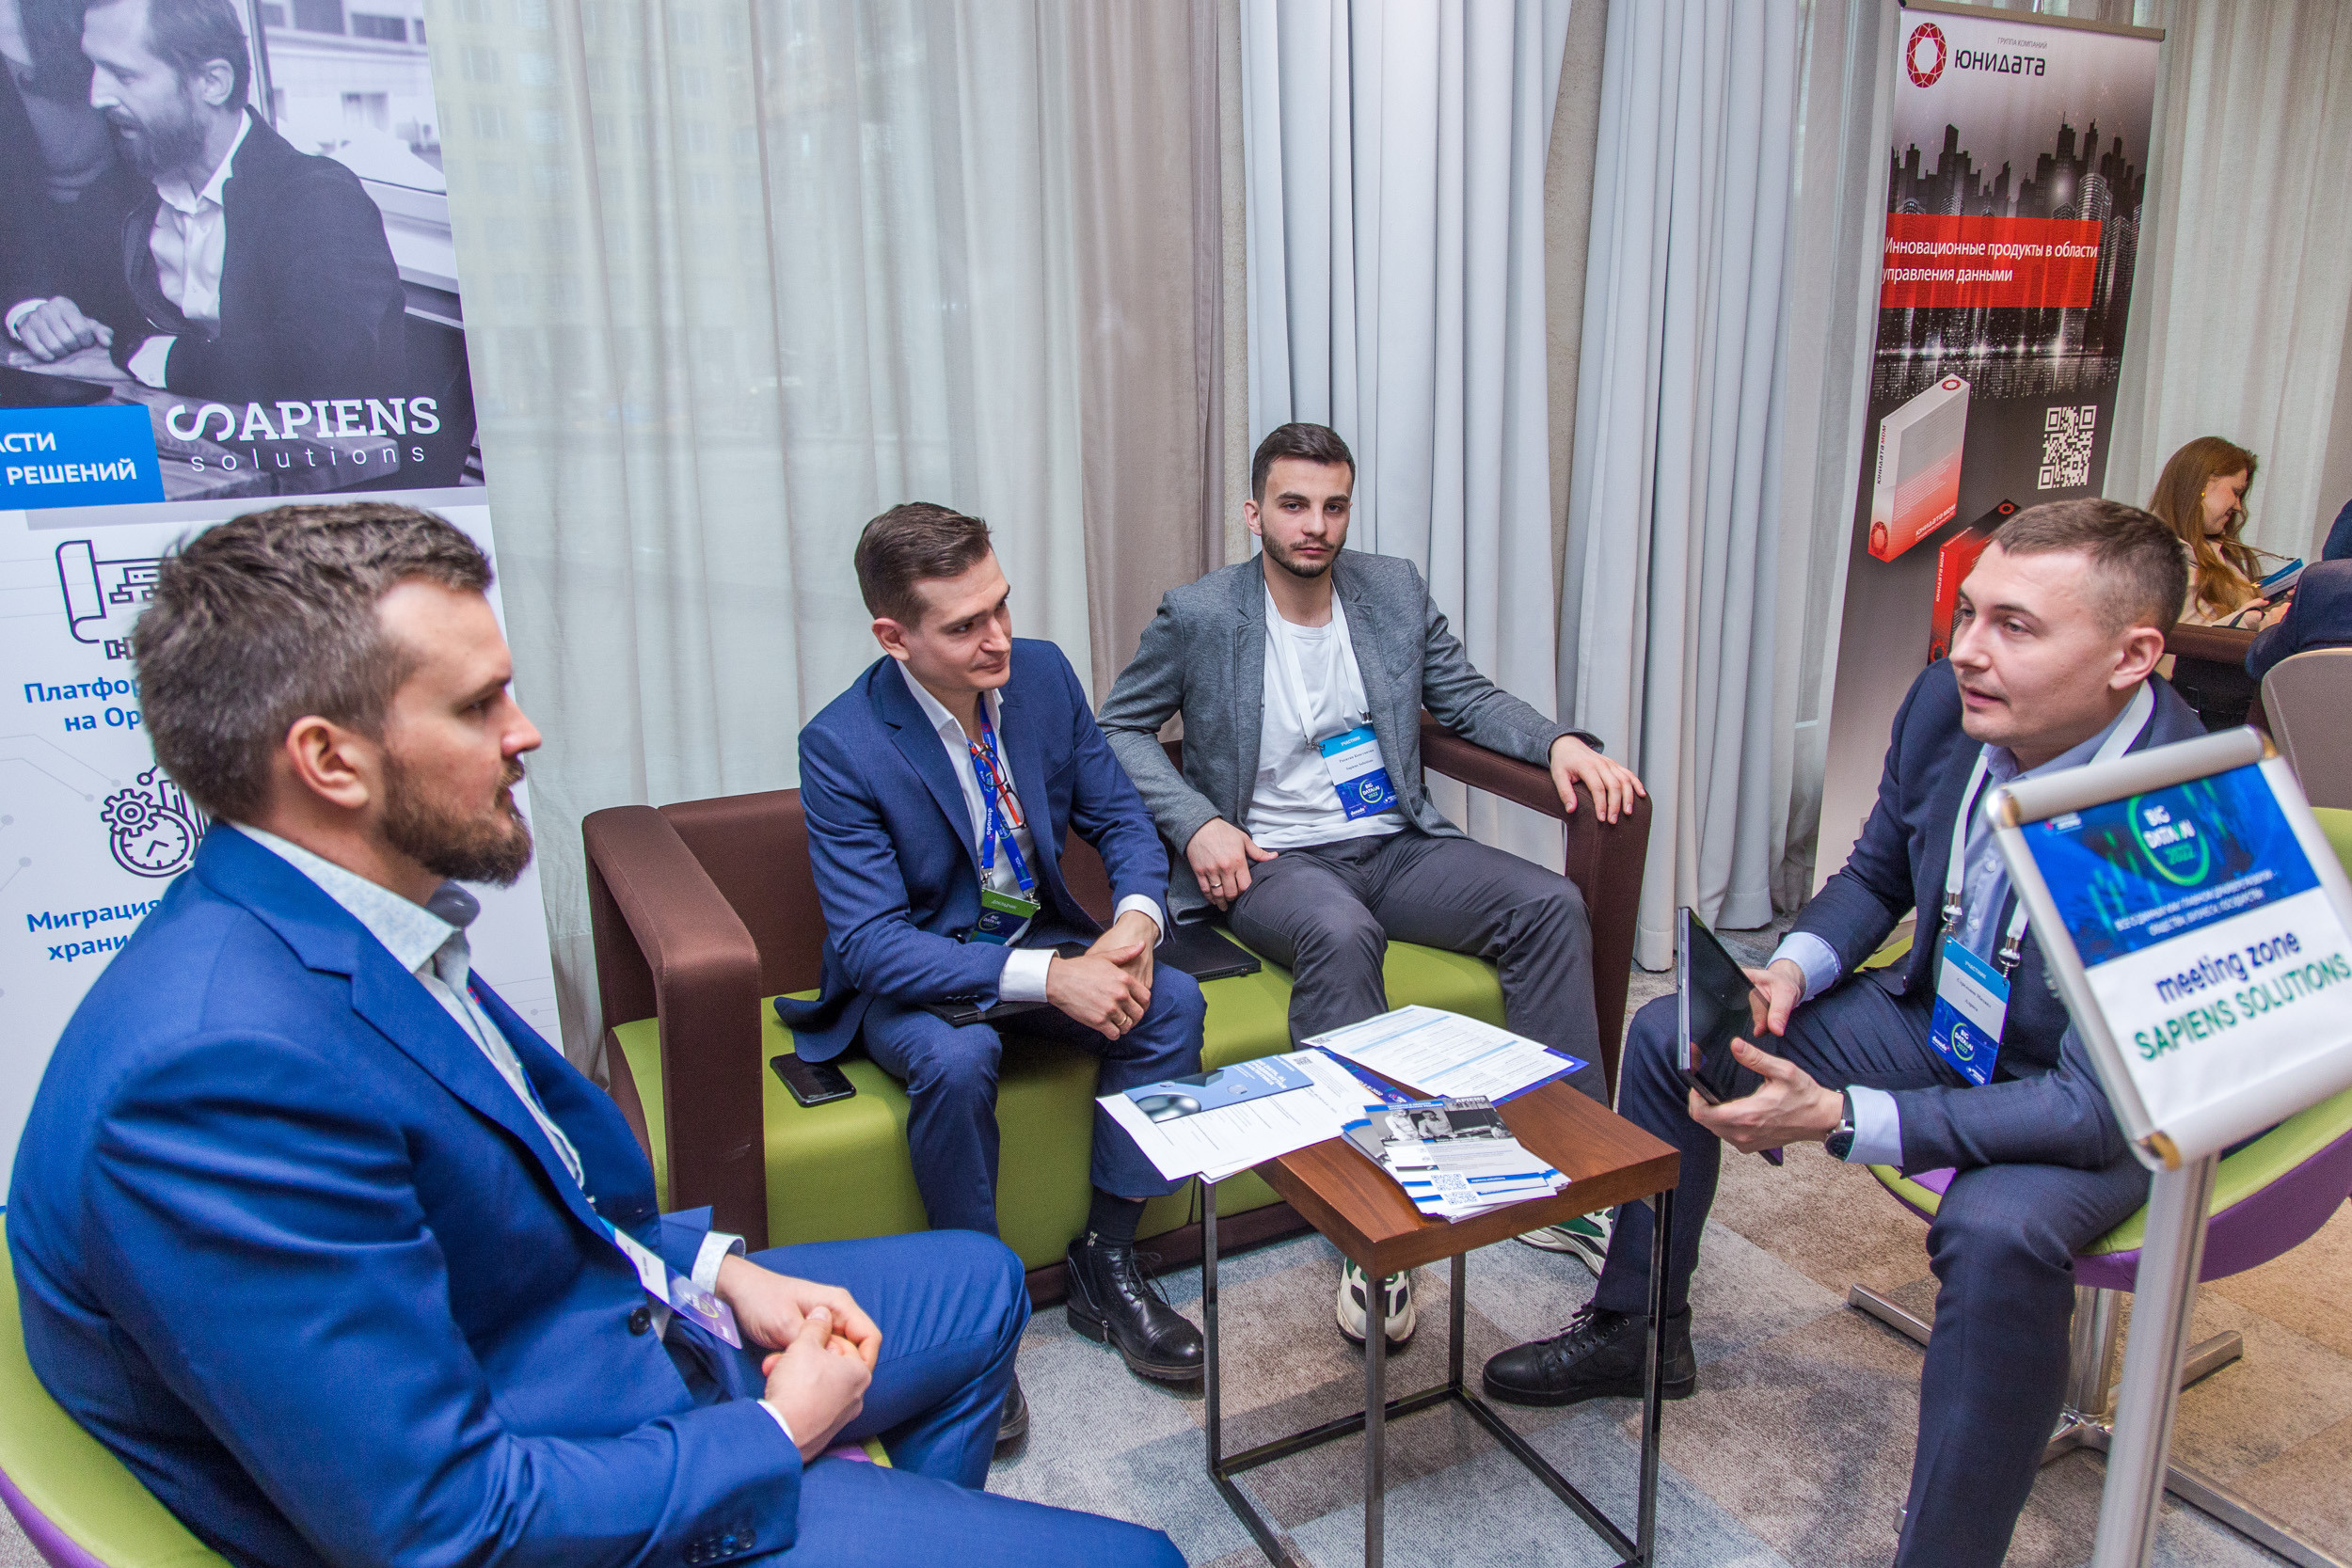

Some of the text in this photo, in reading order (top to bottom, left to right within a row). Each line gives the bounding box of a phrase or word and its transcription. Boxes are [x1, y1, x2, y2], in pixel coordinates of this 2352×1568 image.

[1884, 236, 2098, 260] Инновационные продукты в области
[1882, 267, 2013, 285] управления данными
[6, 457, 137, 486] РЕШЕНИЙ
[190, 446, 425, 472] solutions
[64, 714, 98, 732] на
[986, 807, 994, 836] denodo
[2154, 931, 2302, 1005] meeting zone
[2134, 953, 2352, 1061] SAPIENS SOLUTIONS
